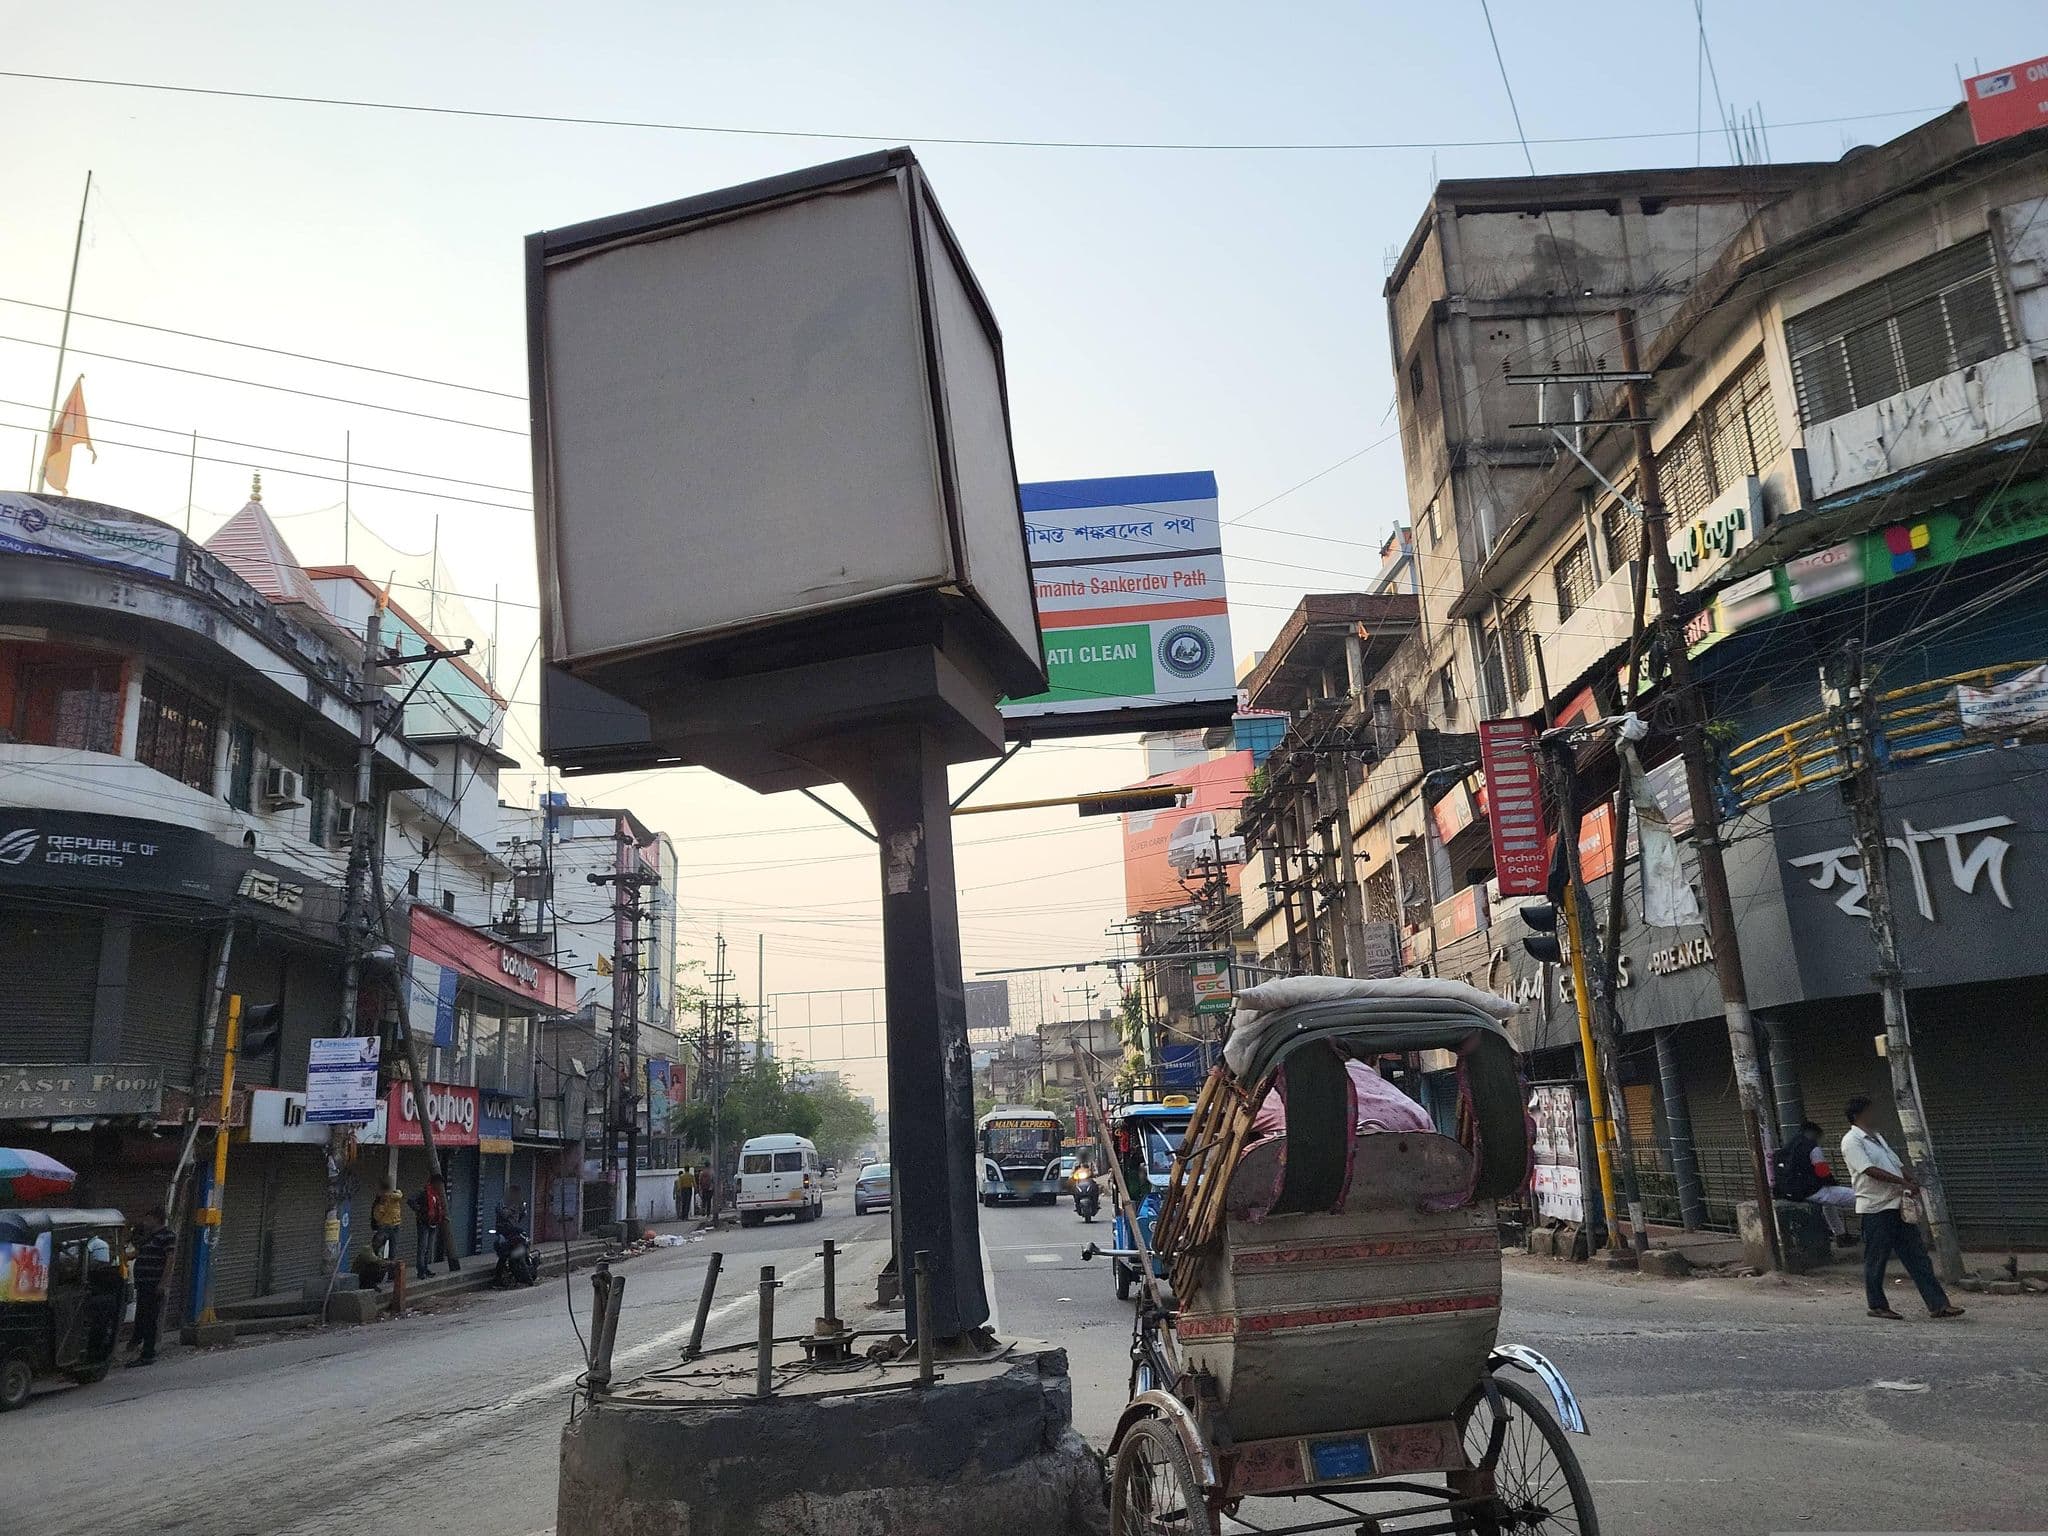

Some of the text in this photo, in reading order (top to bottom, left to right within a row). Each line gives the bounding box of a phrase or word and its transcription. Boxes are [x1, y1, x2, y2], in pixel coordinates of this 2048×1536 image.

[1164, 515, 1196, 536] পথ
[1090, 573, 1169, 596] Sankerdev
[1173, 568, 1207, 590] Path
[1079, 642, 1137, 663] CLEAN
[47, 834, 160, 857] REPUBLIC OF
[45, 850, 124, 868] GAMERS
[1499, 853, 1545, 864] Techno
[1507, 864, 1542, 875] Point
[501, 948, 539, 989] babyhug
[1196, 980, 1225, 991] GSC
[486, 1096, 512, 1121] vivo
[994, 1120, 1053, 1129] MAINA EXPRESS
